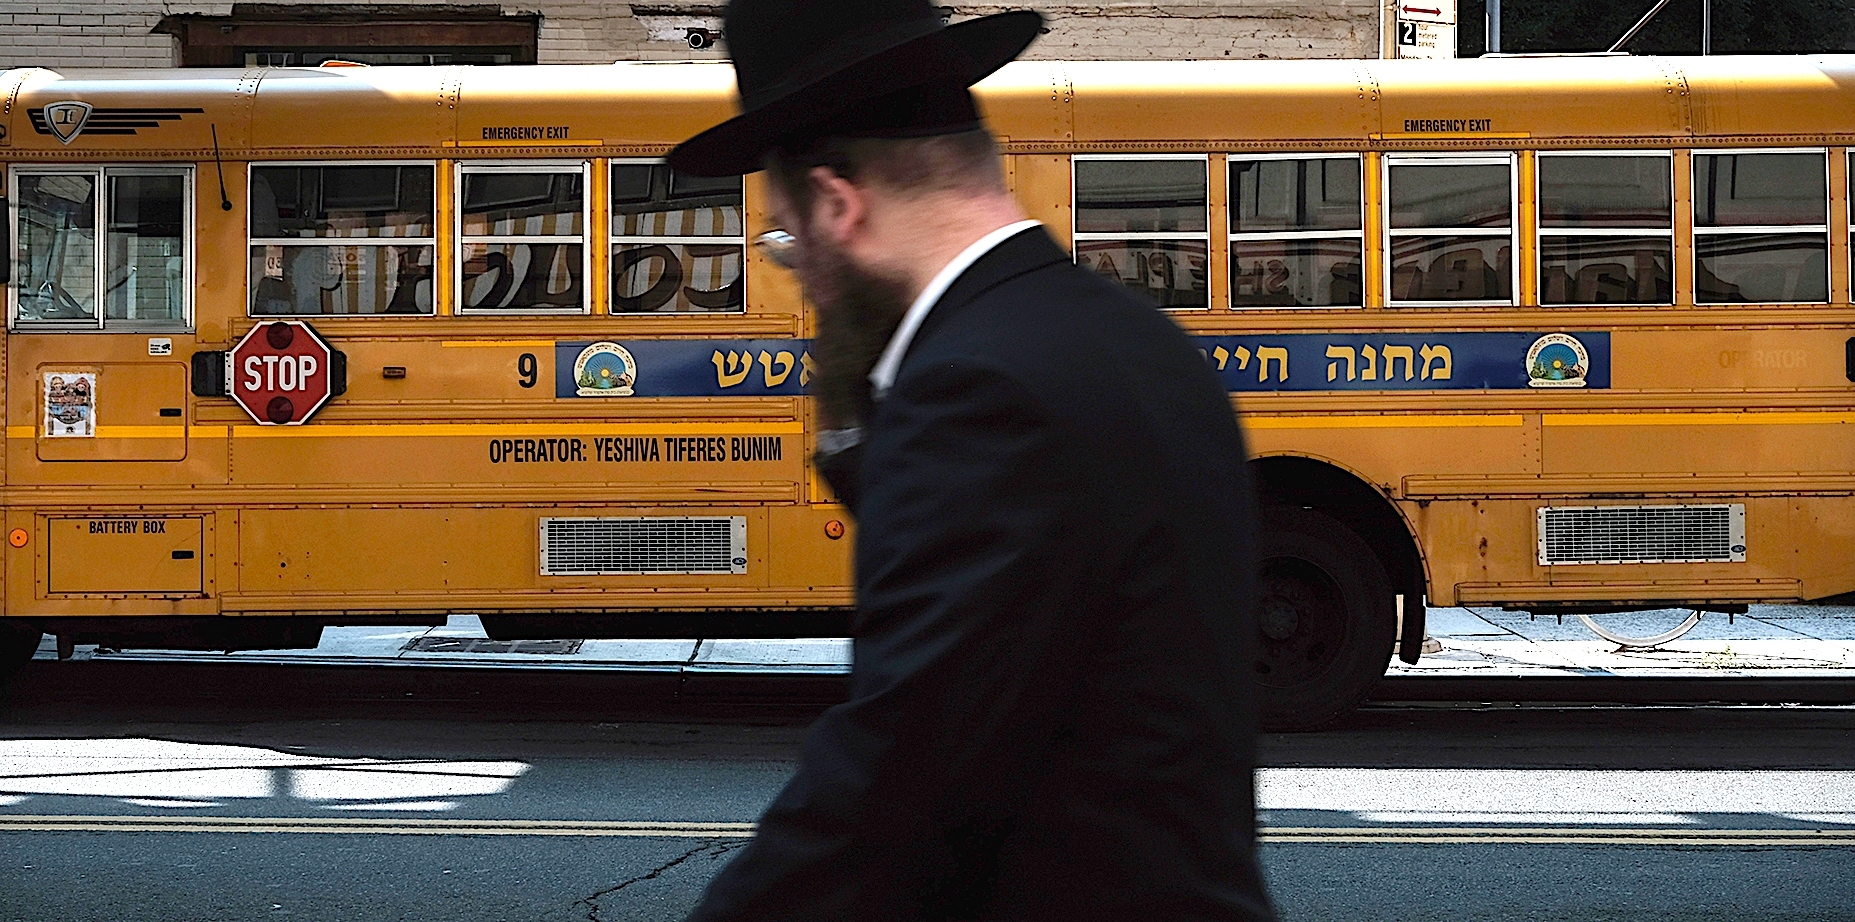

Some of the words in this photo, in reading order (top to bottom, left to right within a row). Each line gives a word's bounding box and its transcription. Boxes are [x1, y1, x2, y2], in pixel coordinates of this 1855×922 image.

[1403, 22, 1413, 43] 2
[482, 126, 545, 140] EMERGENCY
[547, 126, 570, 140] EXIT
[1404, 119, 1467, 132] EMERGENCY
[1468, 118, 1492, 132] EXIT
[244, 355, 317, 391] STOP
[517, 353, 538, 389] 9
[711, 350, 817, 388] אטש
[1198, 345, 1289, 383] חיי
[1326, 343, 1453, 383] מחנה
[489, 438, 587, 464] OPERATOR:
[593, 437, 660, 463] YESHIVA
[663, 436, 726, 462] TIFERES
[731, 436, 782, 462] BUNIM
[89, 520, 138, 534] BATTERY
[143, 520, 166, 534] BOX
